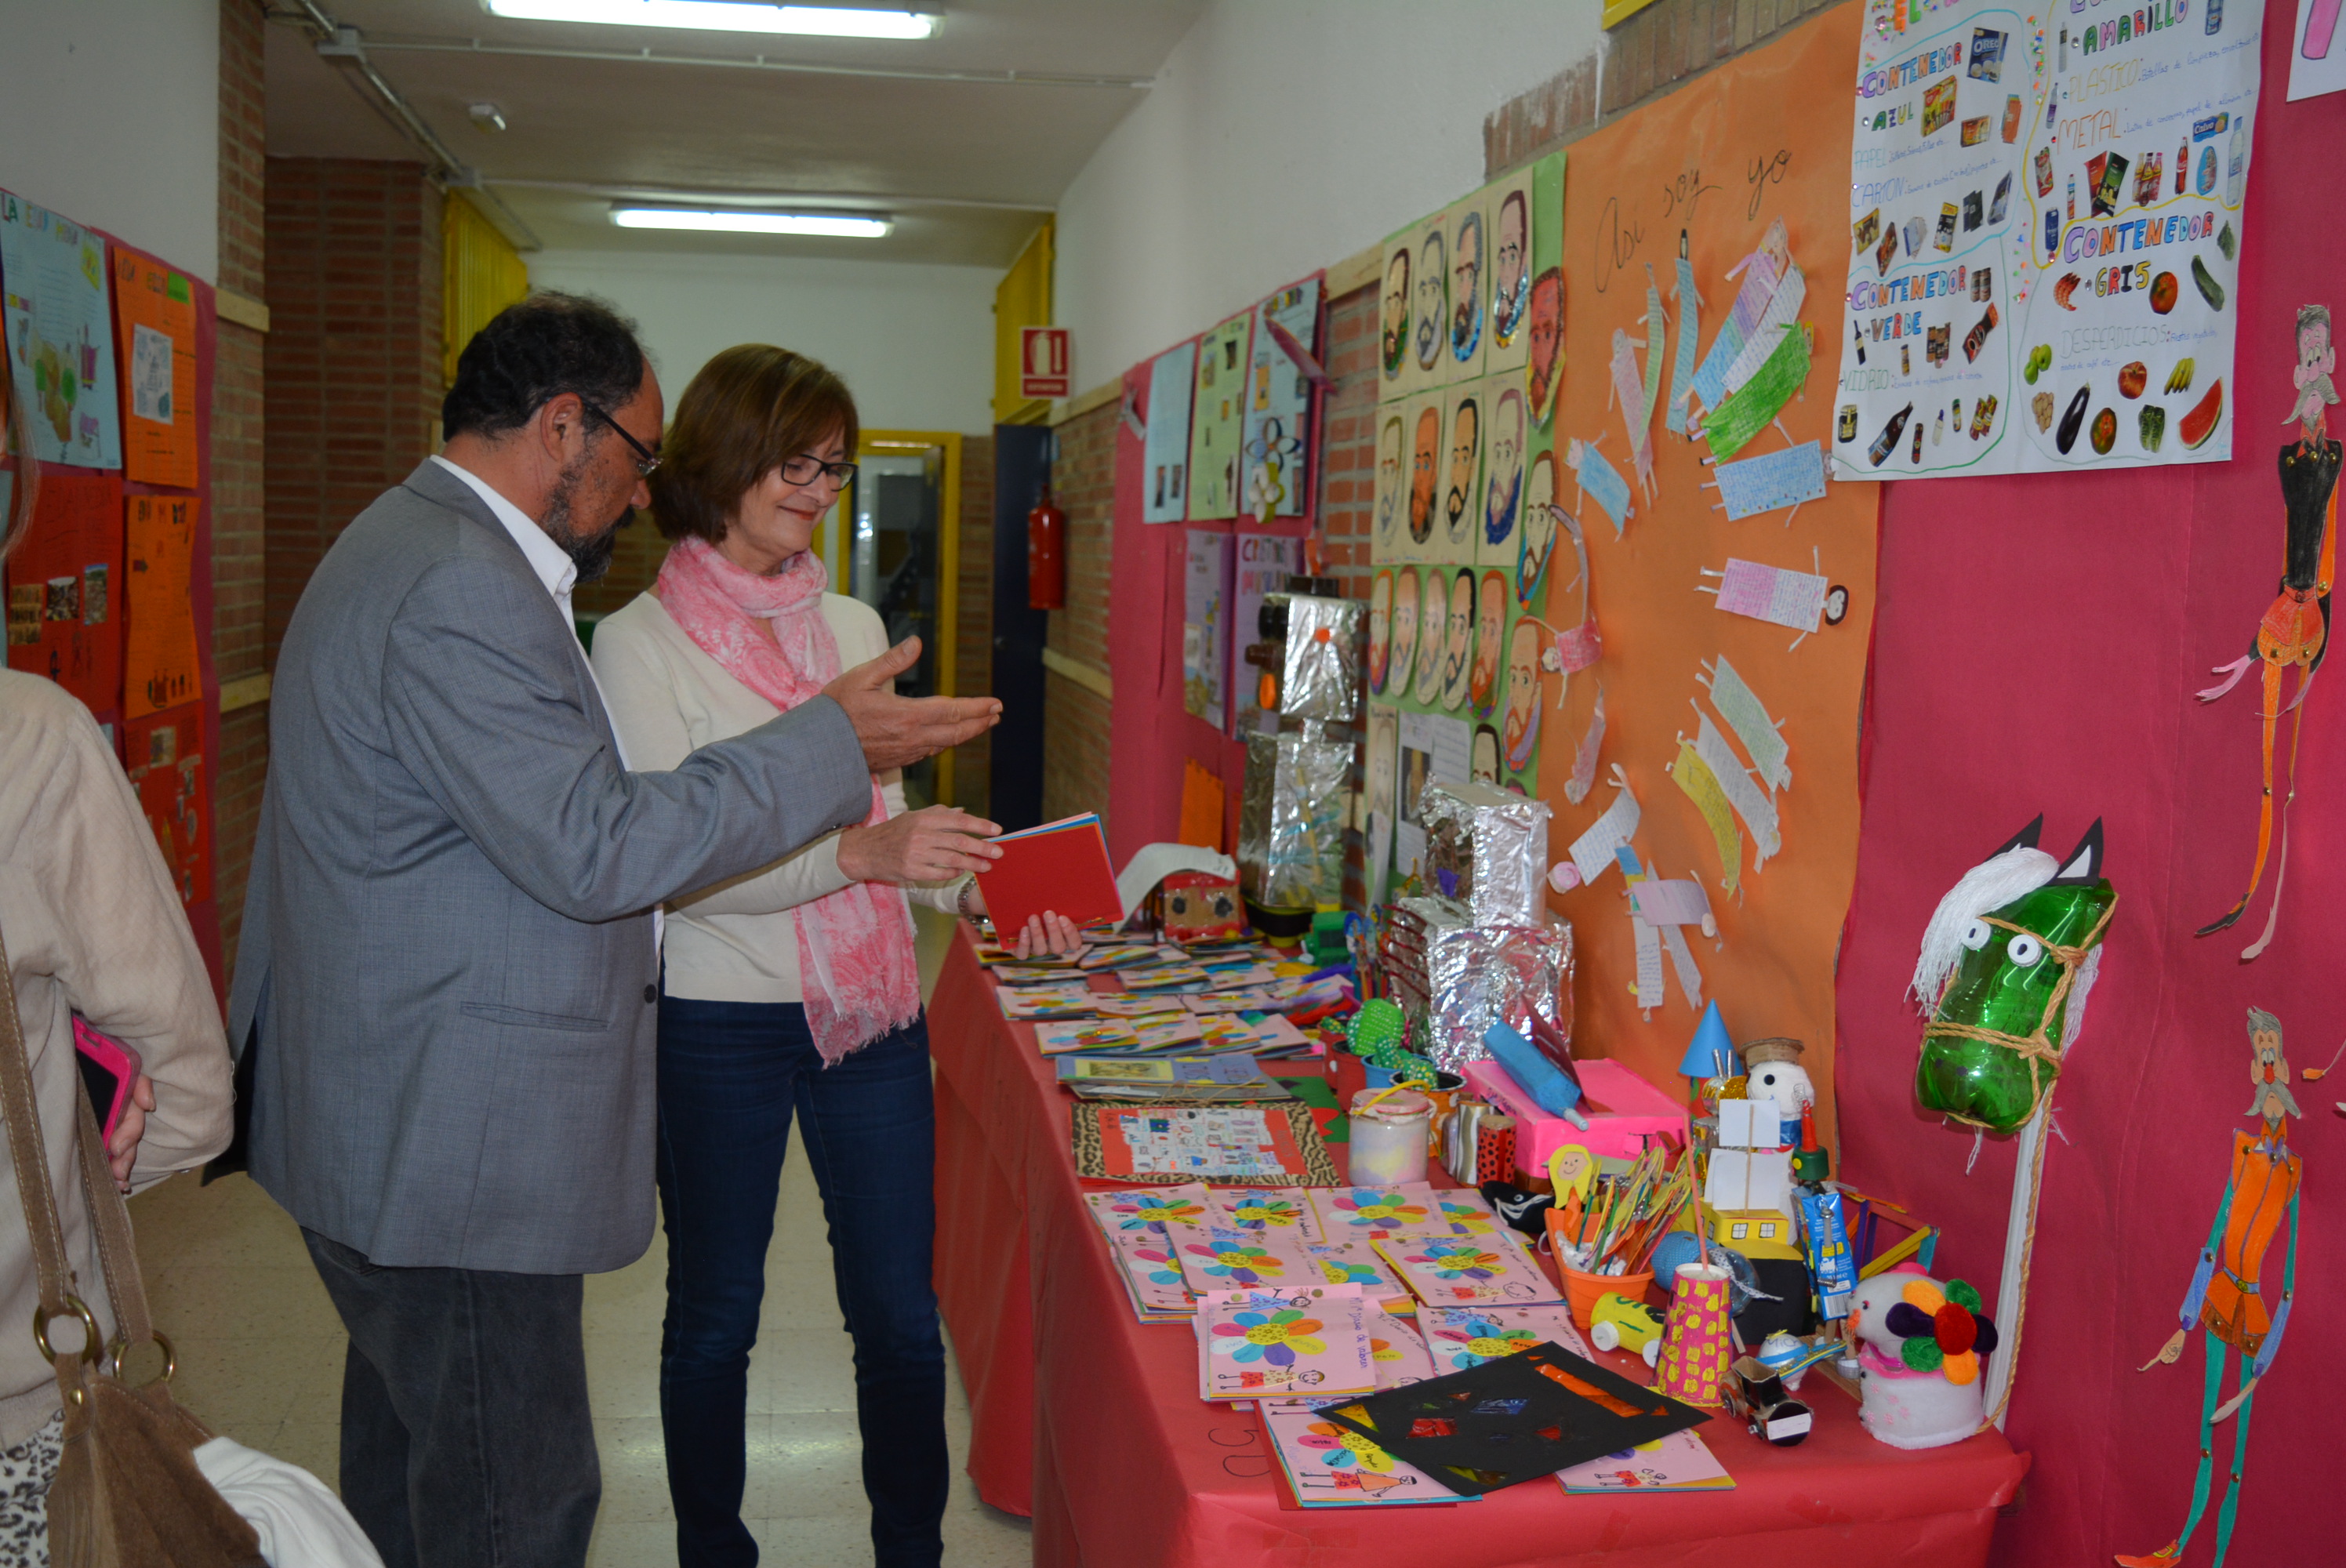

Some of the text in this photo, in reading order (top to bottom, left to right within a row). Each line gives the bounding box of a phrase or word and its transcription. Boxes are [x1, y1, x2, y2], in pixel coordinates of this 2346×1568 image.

[2083, 0, 2188, 56] AMARILLO
[1862, 42, 1962, 99] CONTENEDOR
[1872, 101, 1913, 131] AZUL
[2195, 122, 2214, 134] Calvo
[1747, 150, 1792, 221] yo
[2064, 211, 2214, 263] CONTENEDOR
[1850, 265, 1966, 311] CONTENEDOR
[2095, 260, 2151, 298] GRIS
[1871, 311, 1922, 343] VERDE
[1347, 1312, 1362, 1331] Diario
[1356, 1334, 1368, 1343] de
